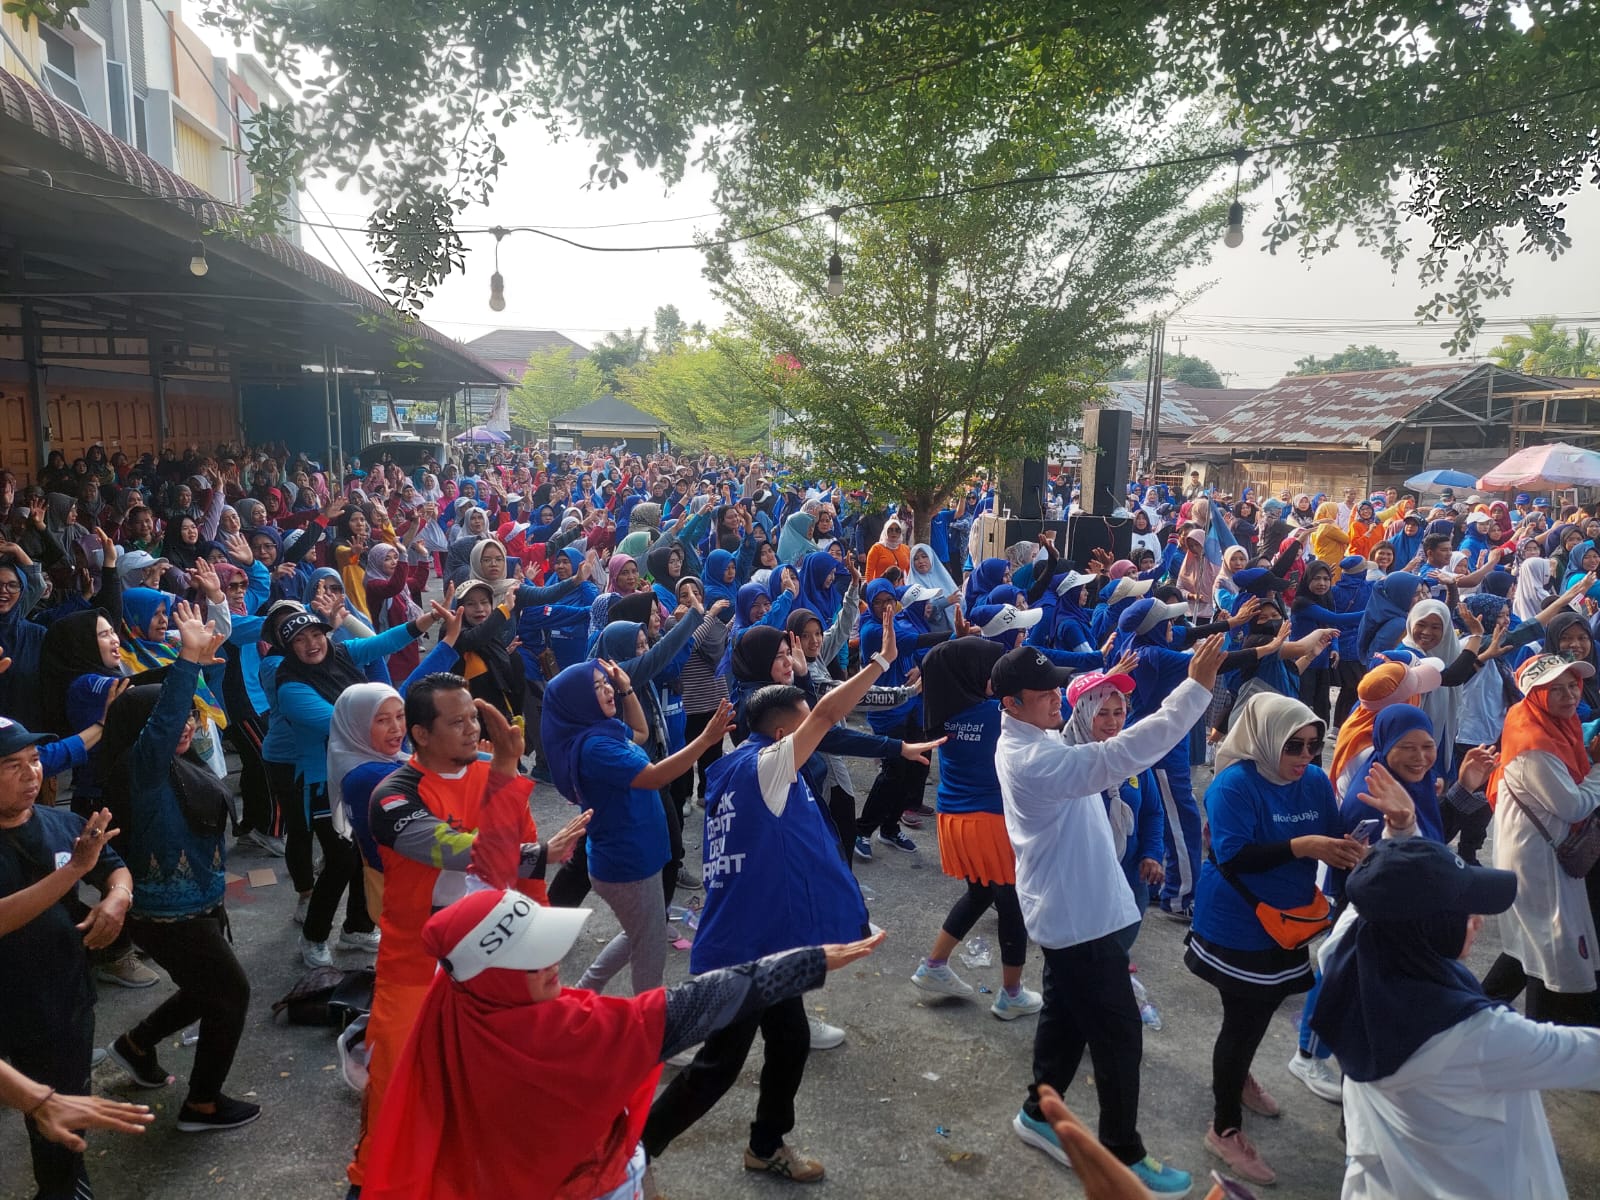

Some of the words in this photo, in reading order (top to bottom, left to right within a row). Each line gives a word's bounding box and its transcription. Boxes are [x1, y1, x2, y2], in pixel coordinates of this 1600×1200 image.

[943, 721, 984, 733] Sahabat
[956, 731, 981, 742] Reza
[479, 895, 534, 956] SPO
